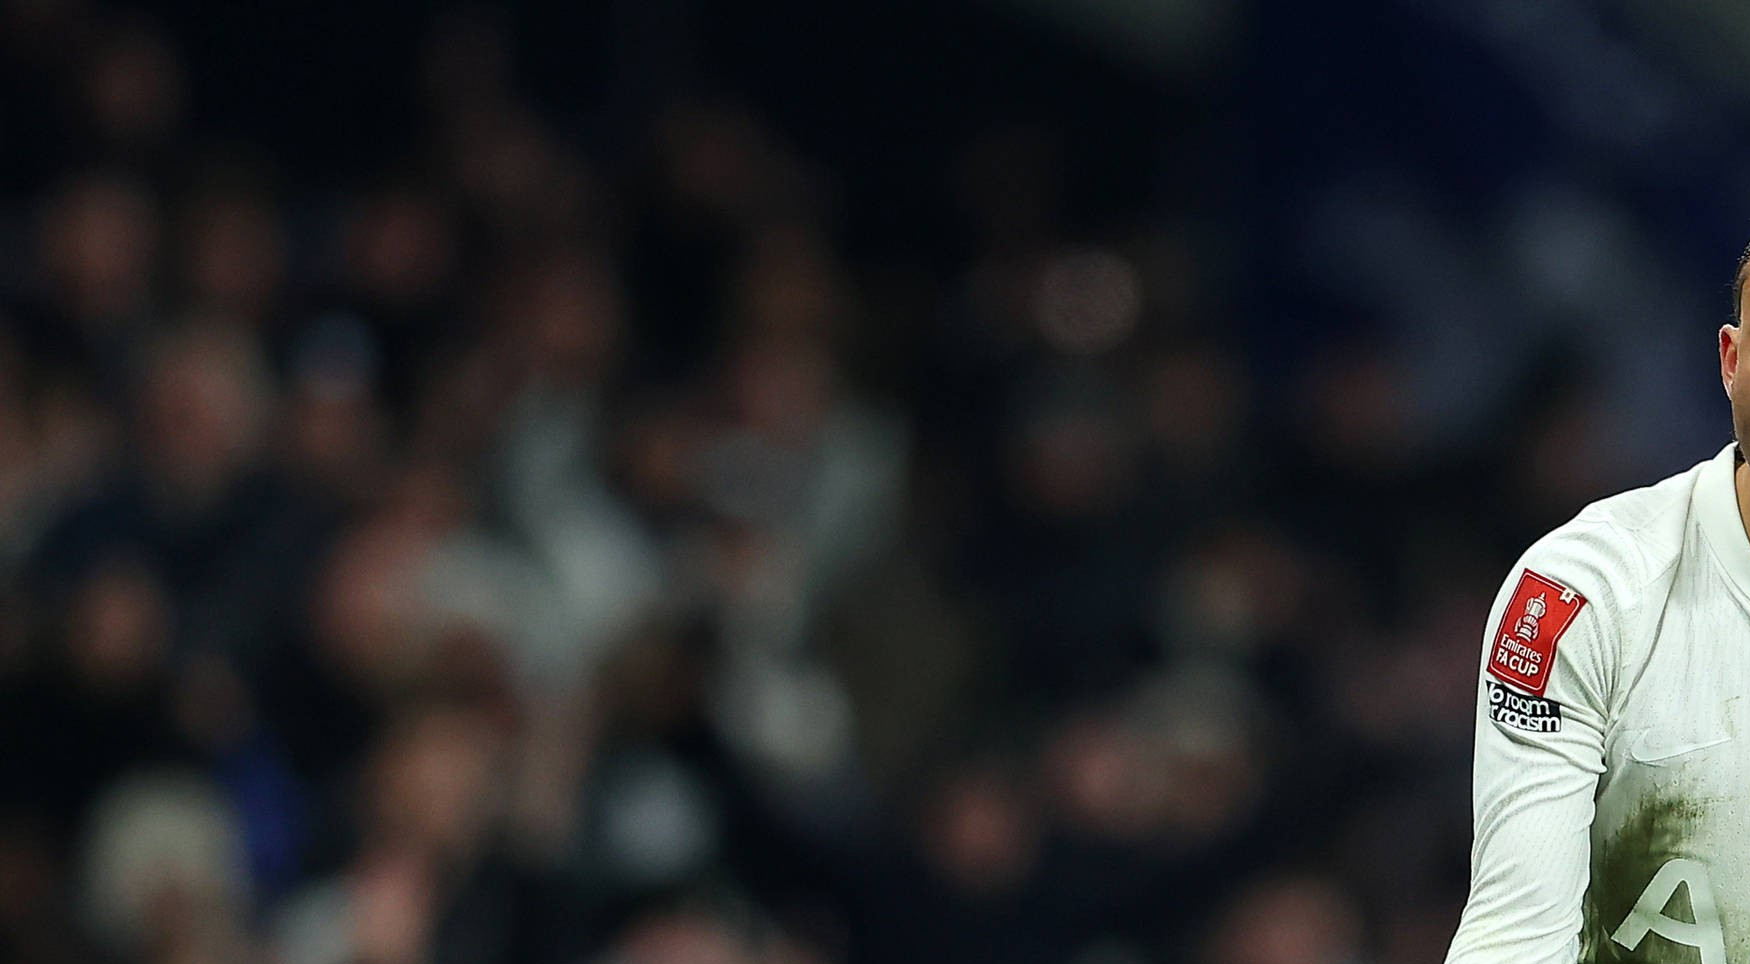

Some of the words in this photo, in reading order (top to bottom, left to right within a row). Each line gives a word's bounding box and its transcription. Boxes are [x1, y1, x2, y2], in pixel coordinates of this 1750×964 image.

[1501, 634, 1542, 663] Emirates
[1496, 648, 1508, 665] FA
[1509, 655, 1538, 676] CUP
[1505, 692, 1550, 715] room
[1497, 707, 1560, 731] racism
